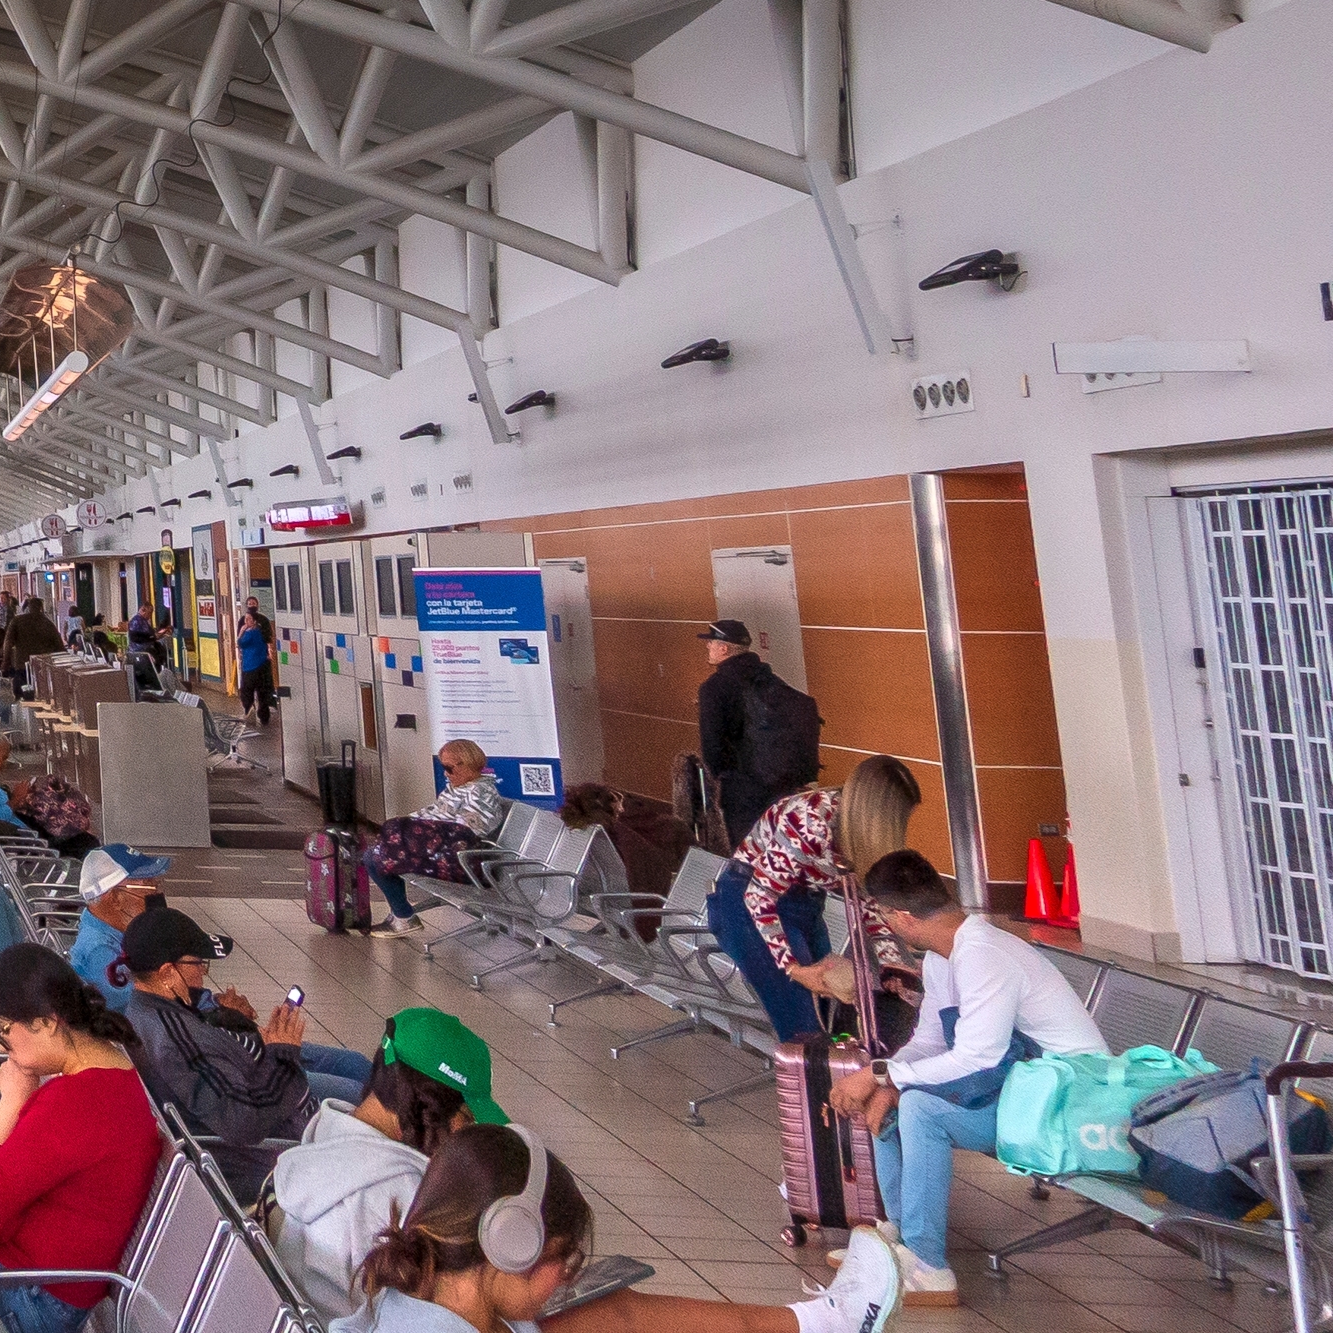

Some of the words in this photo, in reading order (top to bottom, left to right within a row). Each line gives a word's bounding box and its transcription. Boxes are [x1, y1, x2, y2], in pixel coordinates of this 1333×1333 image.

[453, 599, 483, 609] tarjeta
[438, 1062, 467, 1086] MoMA
[859, 1301, 881, 1333] OKA
